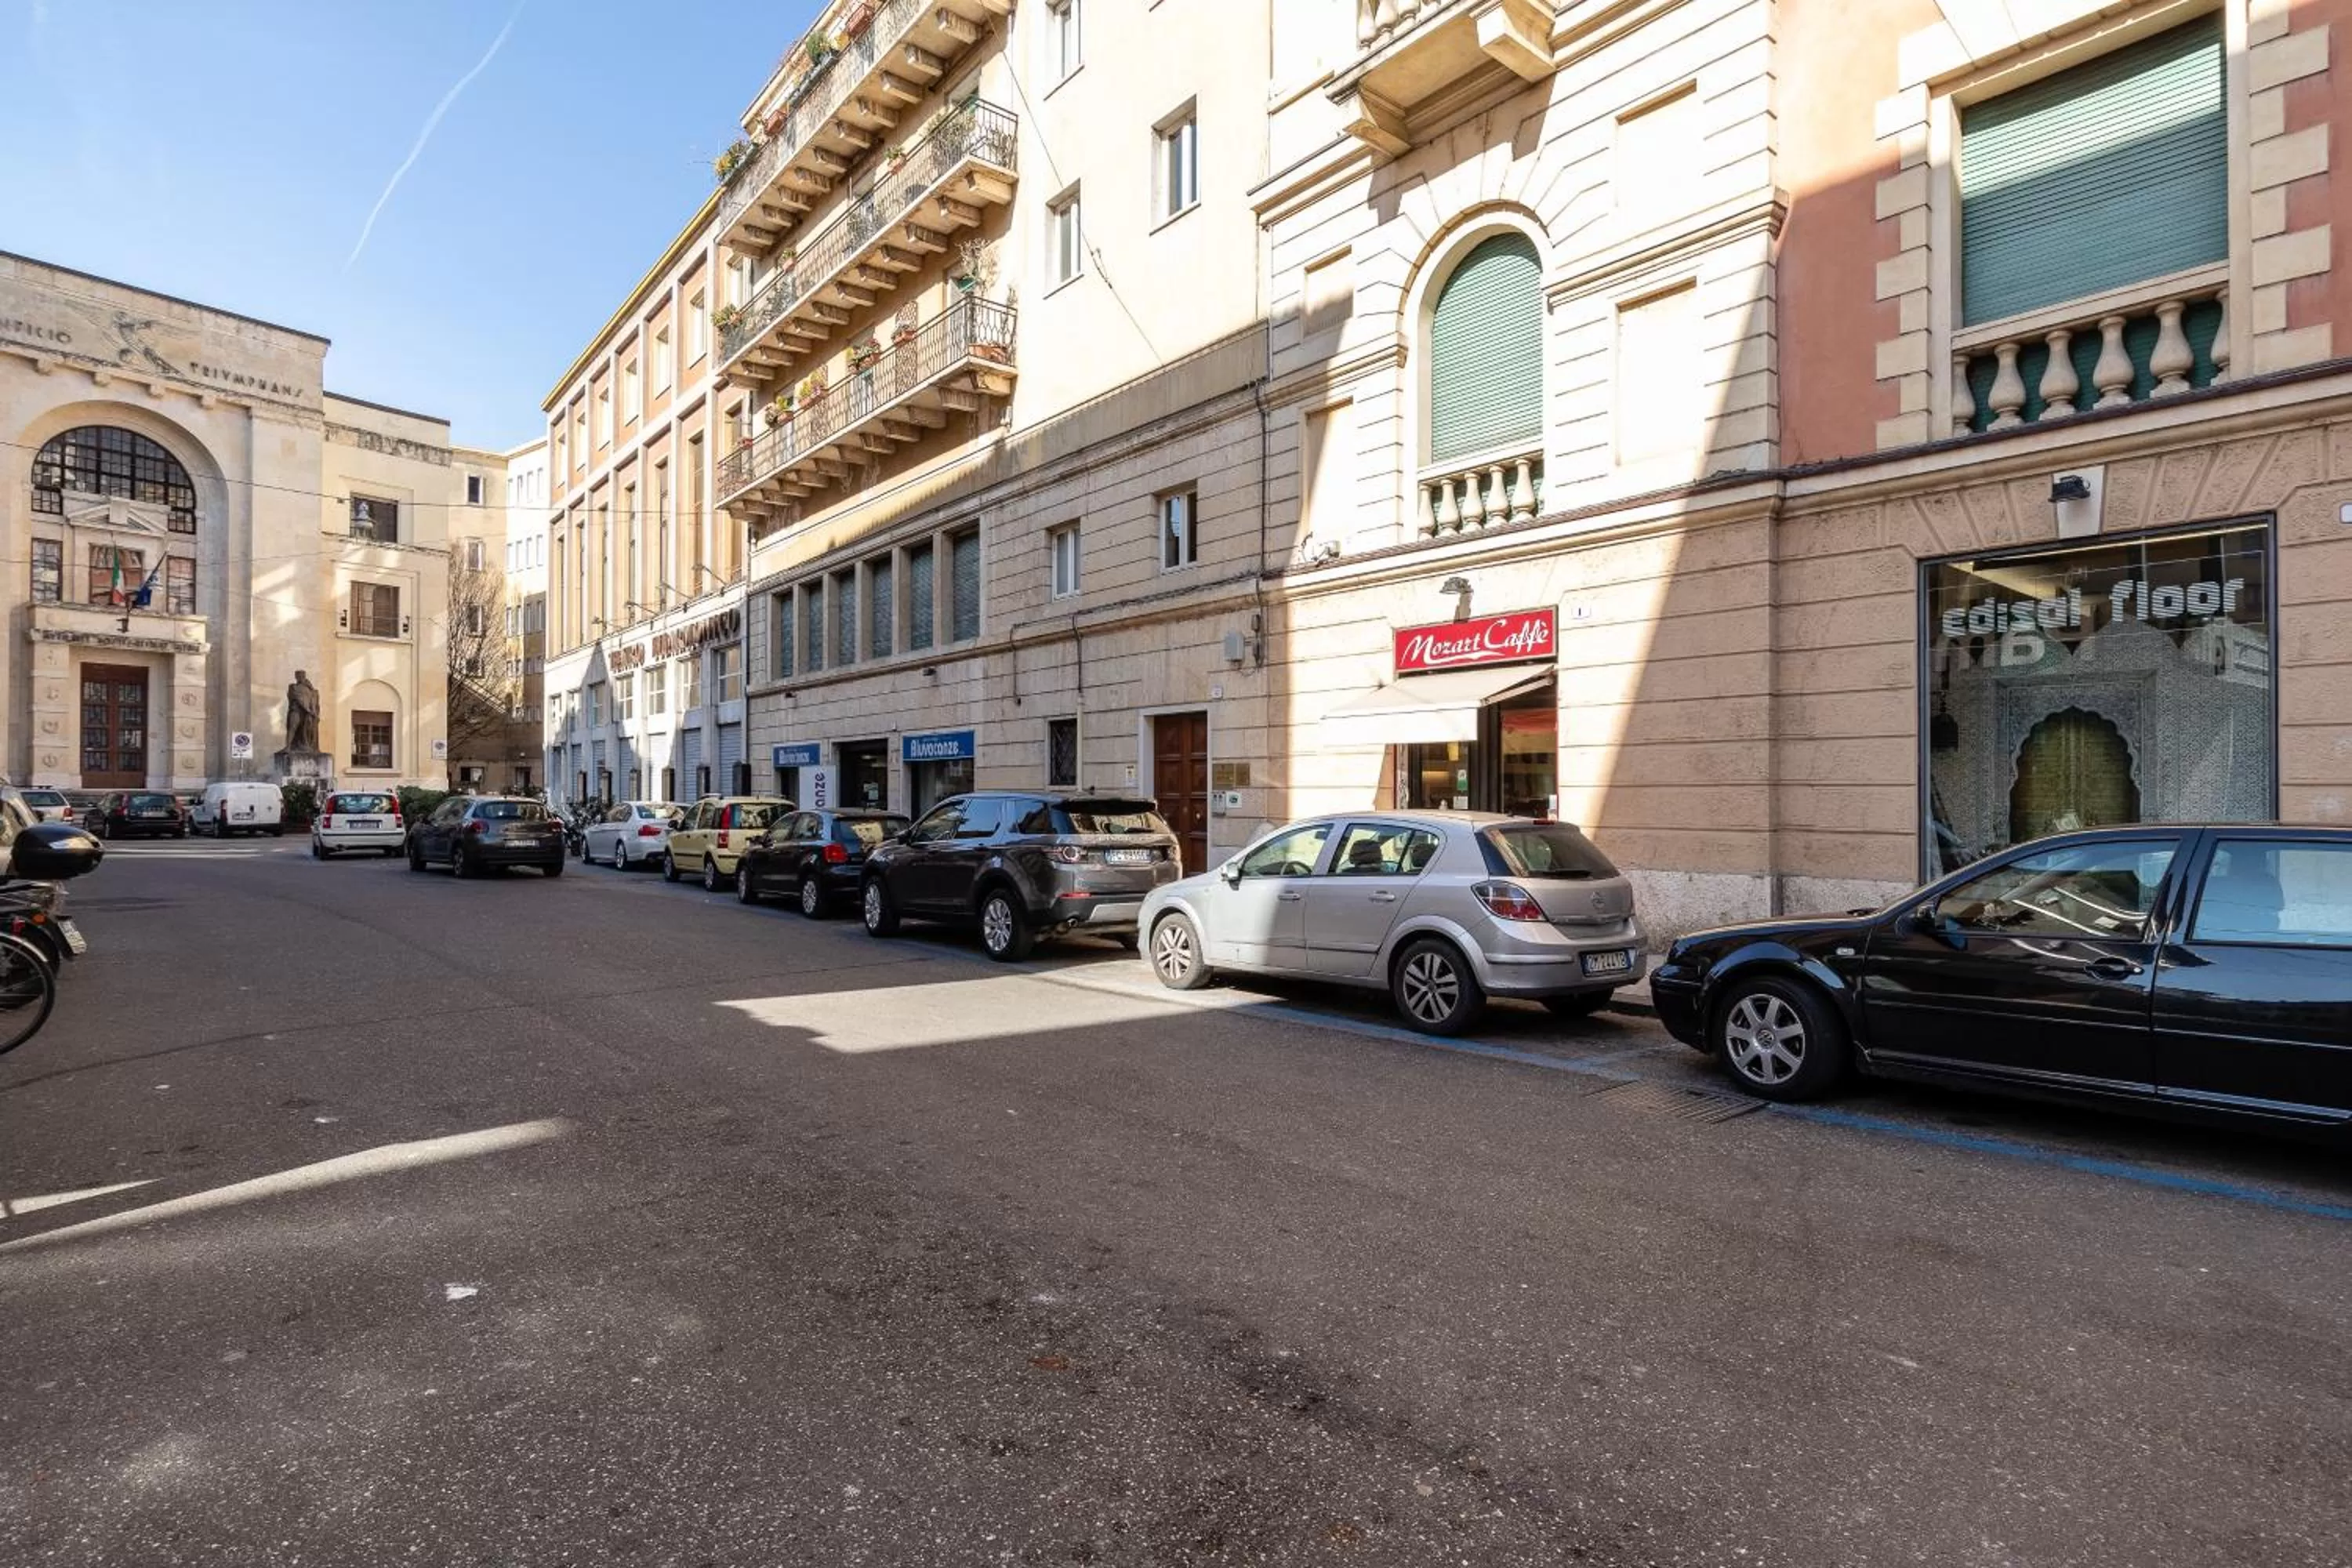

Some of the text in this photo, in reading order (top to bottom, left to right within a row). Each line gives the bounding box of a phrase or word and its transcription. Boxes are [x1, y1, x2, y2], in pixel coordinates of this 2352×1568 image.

[2108, 578, 2245, 622] floor
[1401, 619, 1549, 665] Mozart Caffè
[815, 771, 826, 808] anze
